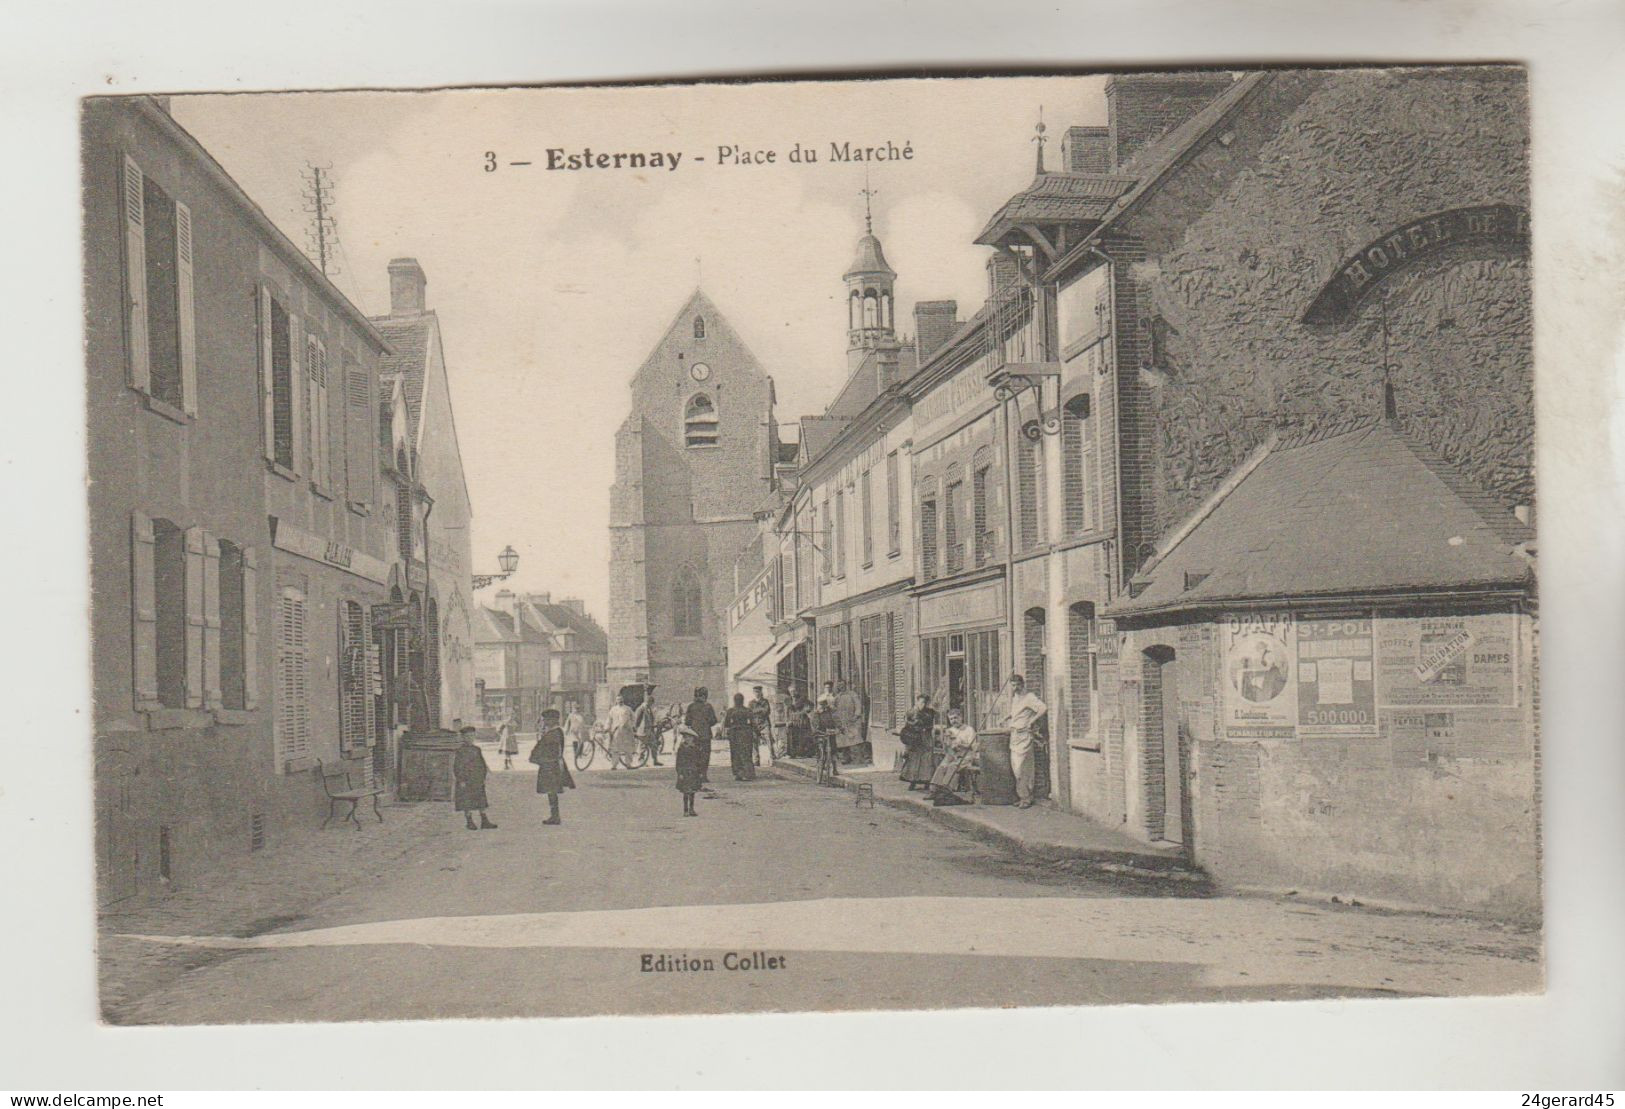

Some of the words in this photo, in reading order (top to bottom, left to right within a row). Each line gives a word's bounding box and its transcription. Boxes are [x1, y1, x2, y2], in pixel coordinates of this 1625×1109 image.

[484, 151, 498, 172] 3
[545, 148, 683, 171] Esternay
[717, 145, 777, 165] Place
[789, 143, 818, 163] du
[829, 140, 914, 163] Marché
[1344, 218, 1442, 289] HOTEL
[737, 596, 752, 620] LE
[1417, 629, 1471, 675] LIQUIDATION
[1473, 653, 1511, 665] DAMES
[640, 953, 714, 972] Edition
[723, 951, 787, 971] Collet
